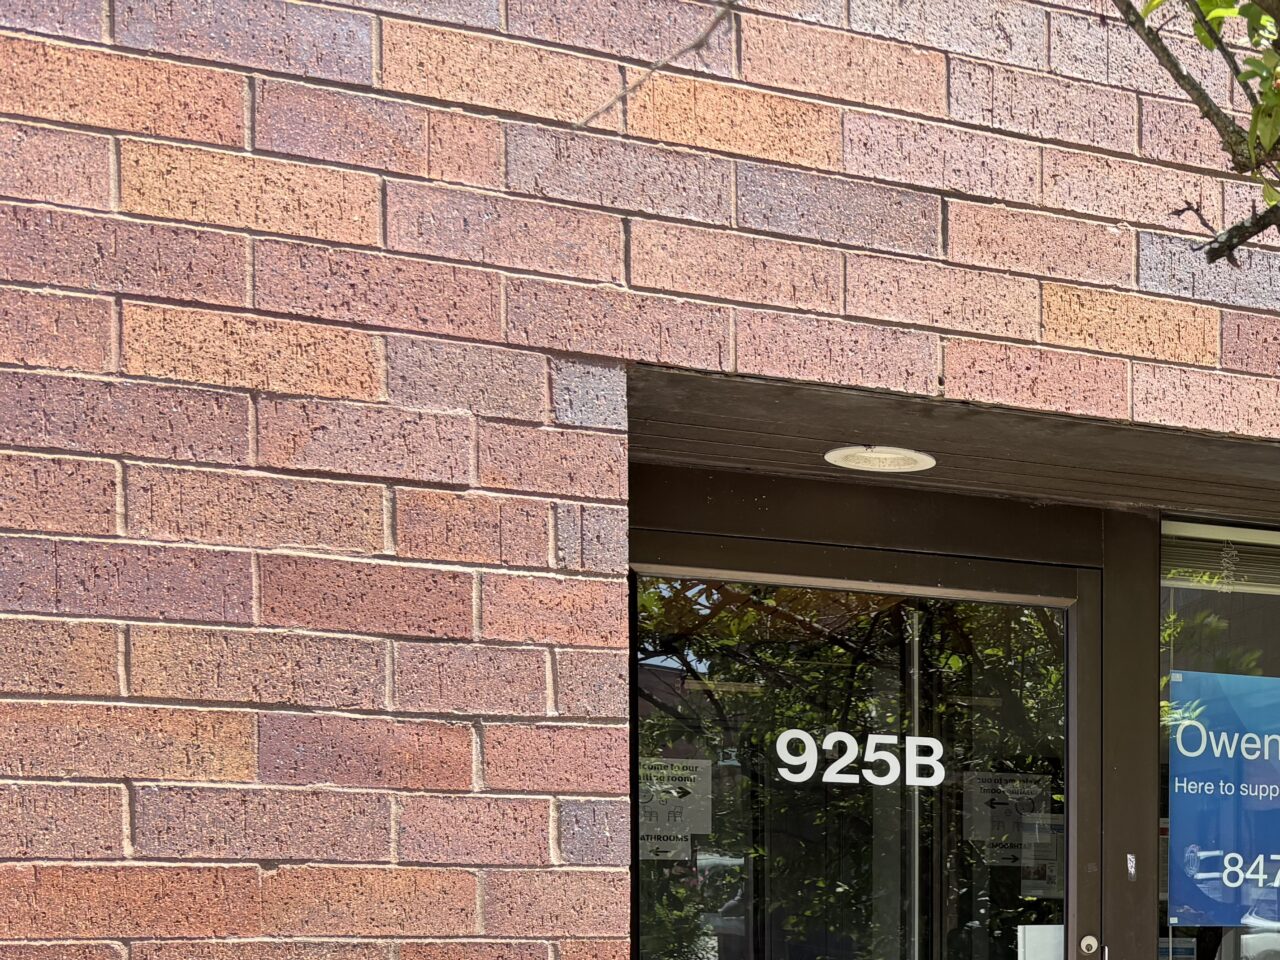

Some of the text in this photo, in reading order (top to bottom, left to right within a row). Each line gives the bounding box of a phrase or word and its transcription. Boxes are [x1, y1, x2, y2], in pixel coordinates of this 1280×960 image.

[775, 728, 946, 787] 925B
[1174, 777, 1214, 794] Here
[1219, 779, 1235, 795] to
